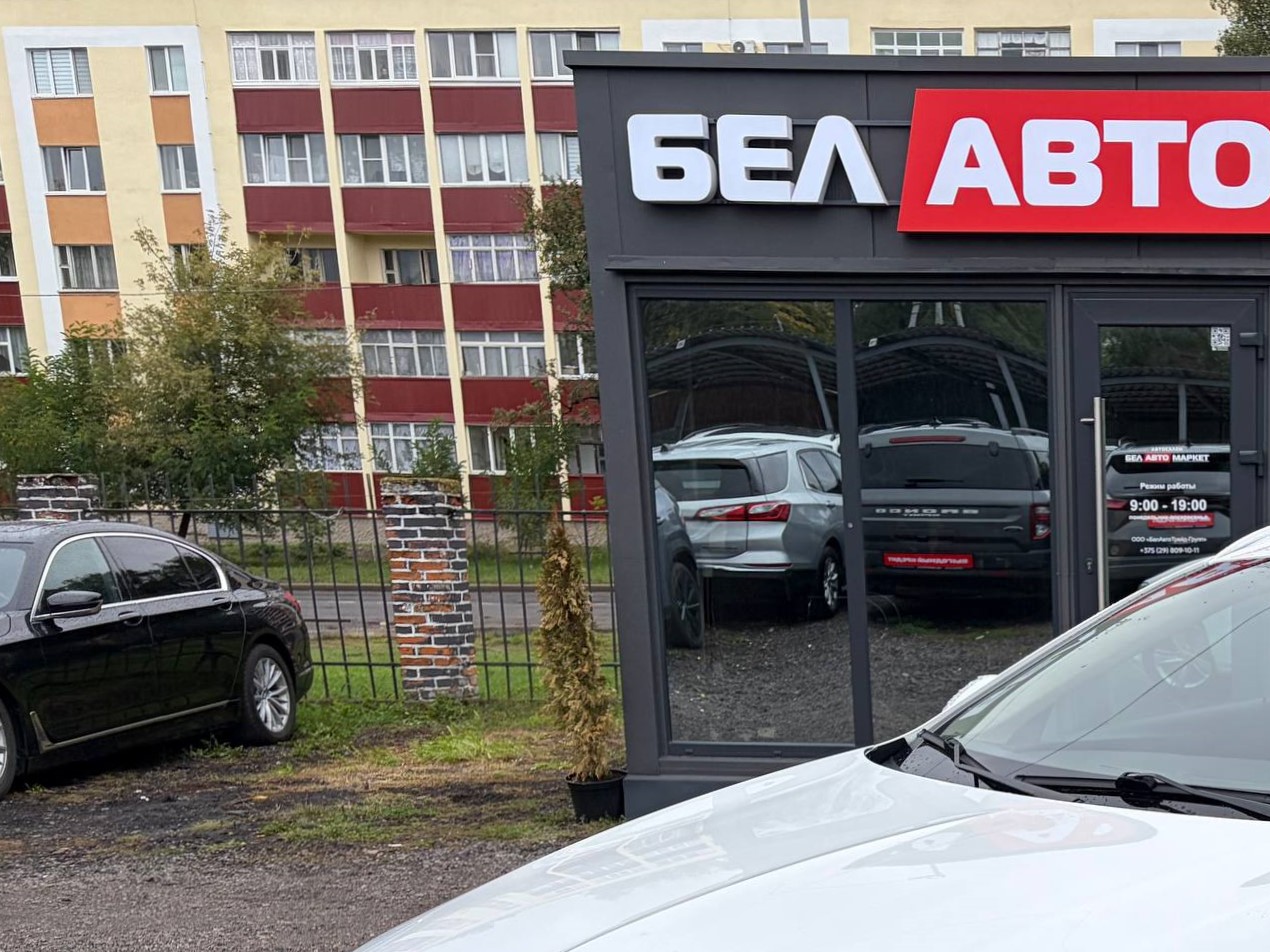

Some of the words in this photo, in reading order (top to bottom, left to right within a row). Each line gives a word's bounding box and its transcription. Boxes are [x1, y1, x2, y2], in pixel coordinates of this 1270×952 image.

[626, 114, 888, 205] БЕЛ
[1125, 454, 1143, 463] БЕЛ
[1144, 454, 1170, 462] АВТО
[1172, 454, 1210, 463] МАРКЕТ
[1140, 482, 1166, 490] Режим
[1167, 482, 1197, 491] работы
[1129, 499, 1159, 512] 9:00
[1171, 499, 1207, 512] 19:00
